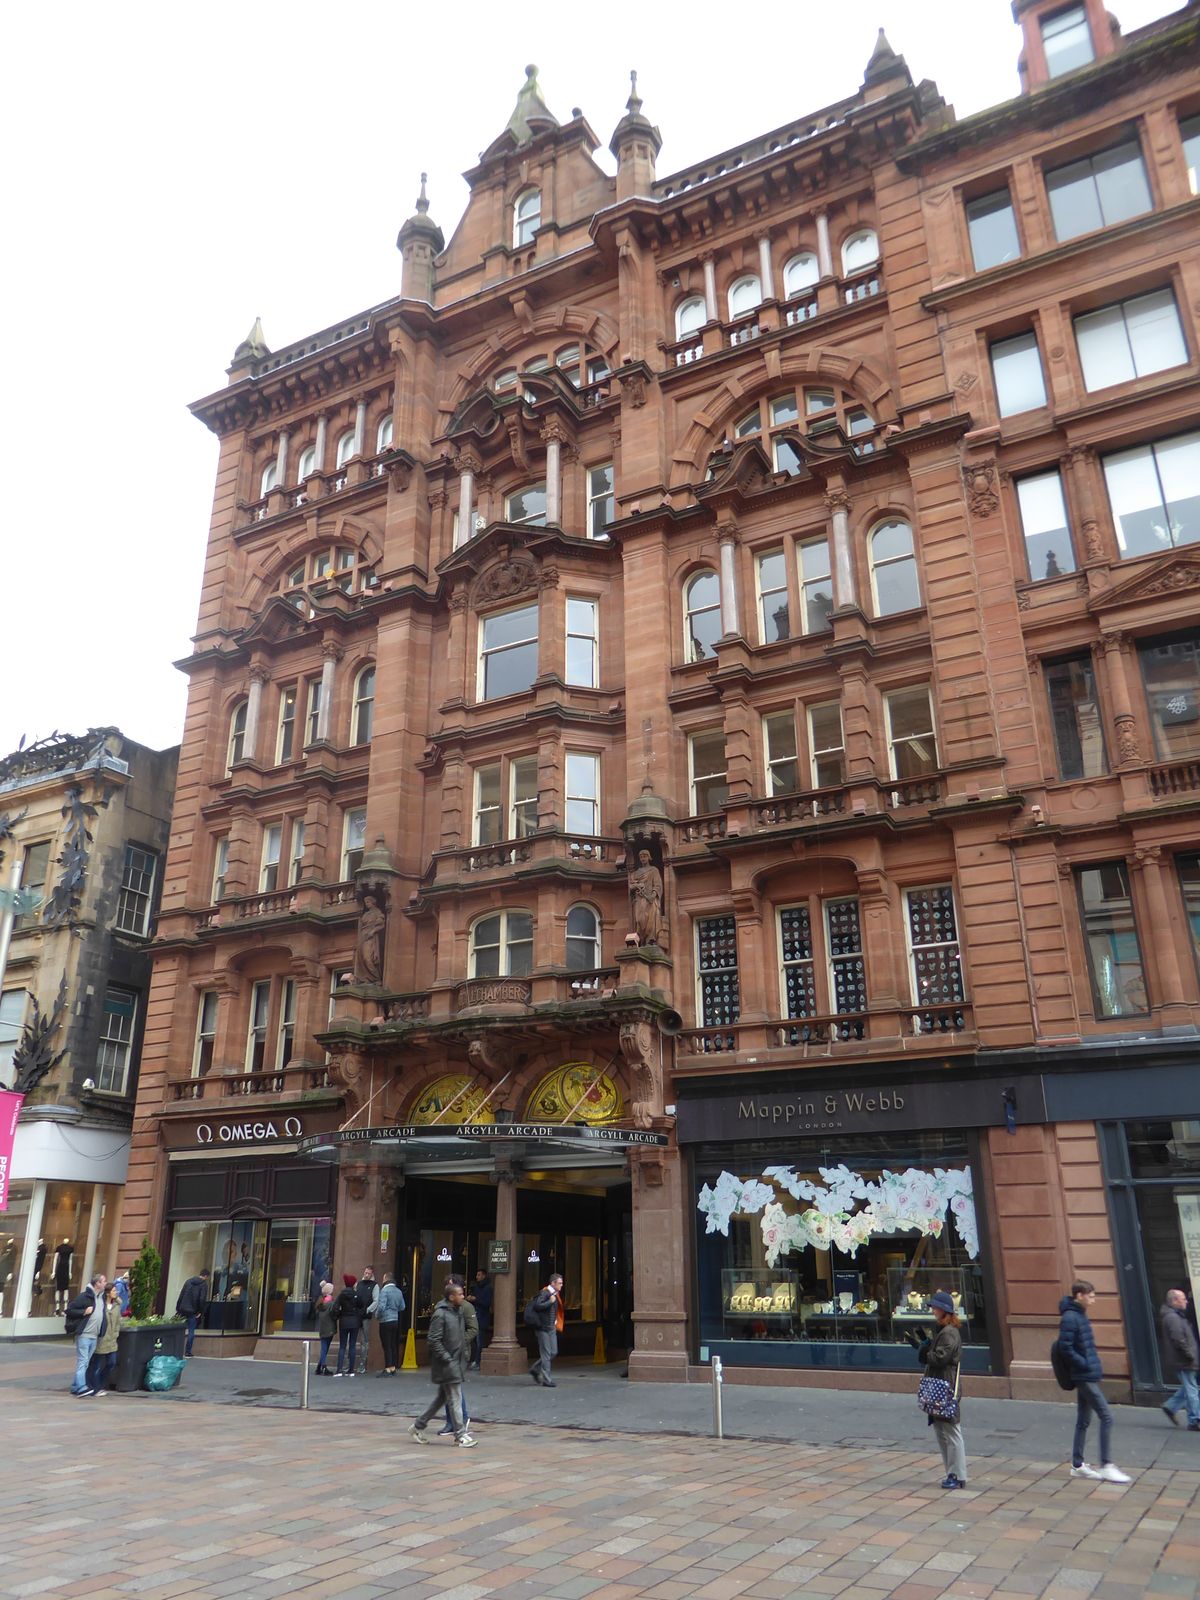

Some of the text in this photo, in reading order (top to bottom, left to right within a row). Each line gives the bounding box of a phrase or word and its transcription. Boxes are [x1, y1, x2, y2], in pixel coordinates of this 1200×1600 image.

[738, 1090, 904, 1123] Mappin & Webb
[220, 1122, 278, 1141] OMEGA
[340, 1127, 416, 1140] ARGYLL ARCADE
[456, 1126, 553, 1136] ARGYLL ARCADE
[586, 1129, 658, 1144] ARGYLL ARCADE
